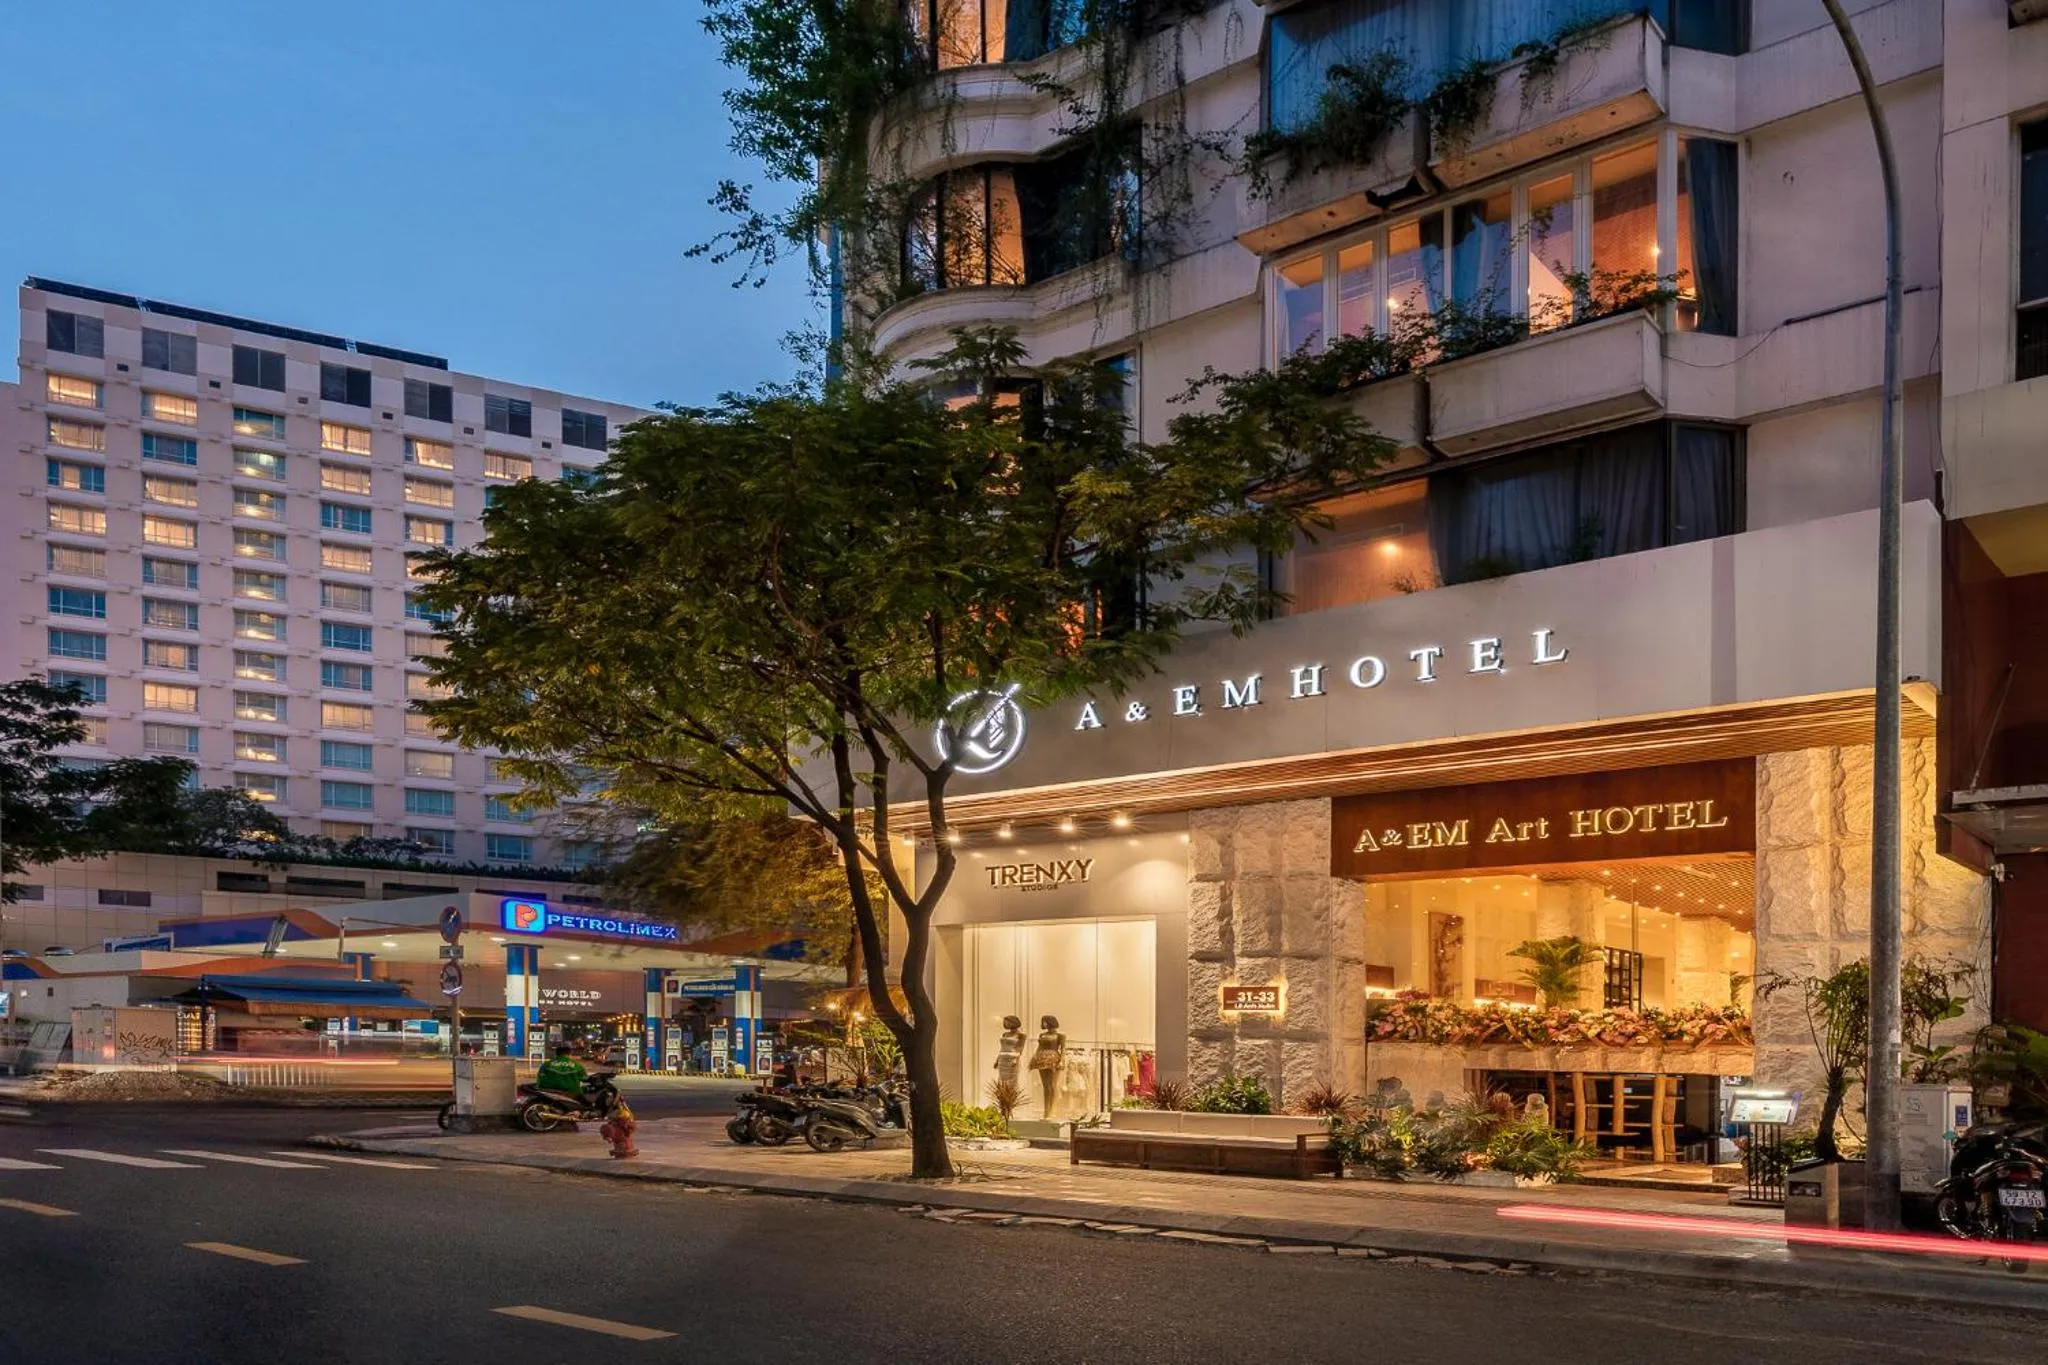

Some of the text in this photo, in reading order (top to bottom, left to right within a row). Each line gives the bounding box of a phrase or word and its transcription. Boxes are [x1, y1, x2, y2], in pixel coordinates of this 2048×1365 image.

[1075, 628, 1568, 730] A & EM HOTEL
[1353, 800, 1728, 853] A&EM Art HOTEL
[985, 859, 1094, 886] TRENXY
[547, 914, 676, 939] PETROLIMEX
[541, 989, 602, 999] WORLD
[1237, 991, 1276, 1002] 31-33
